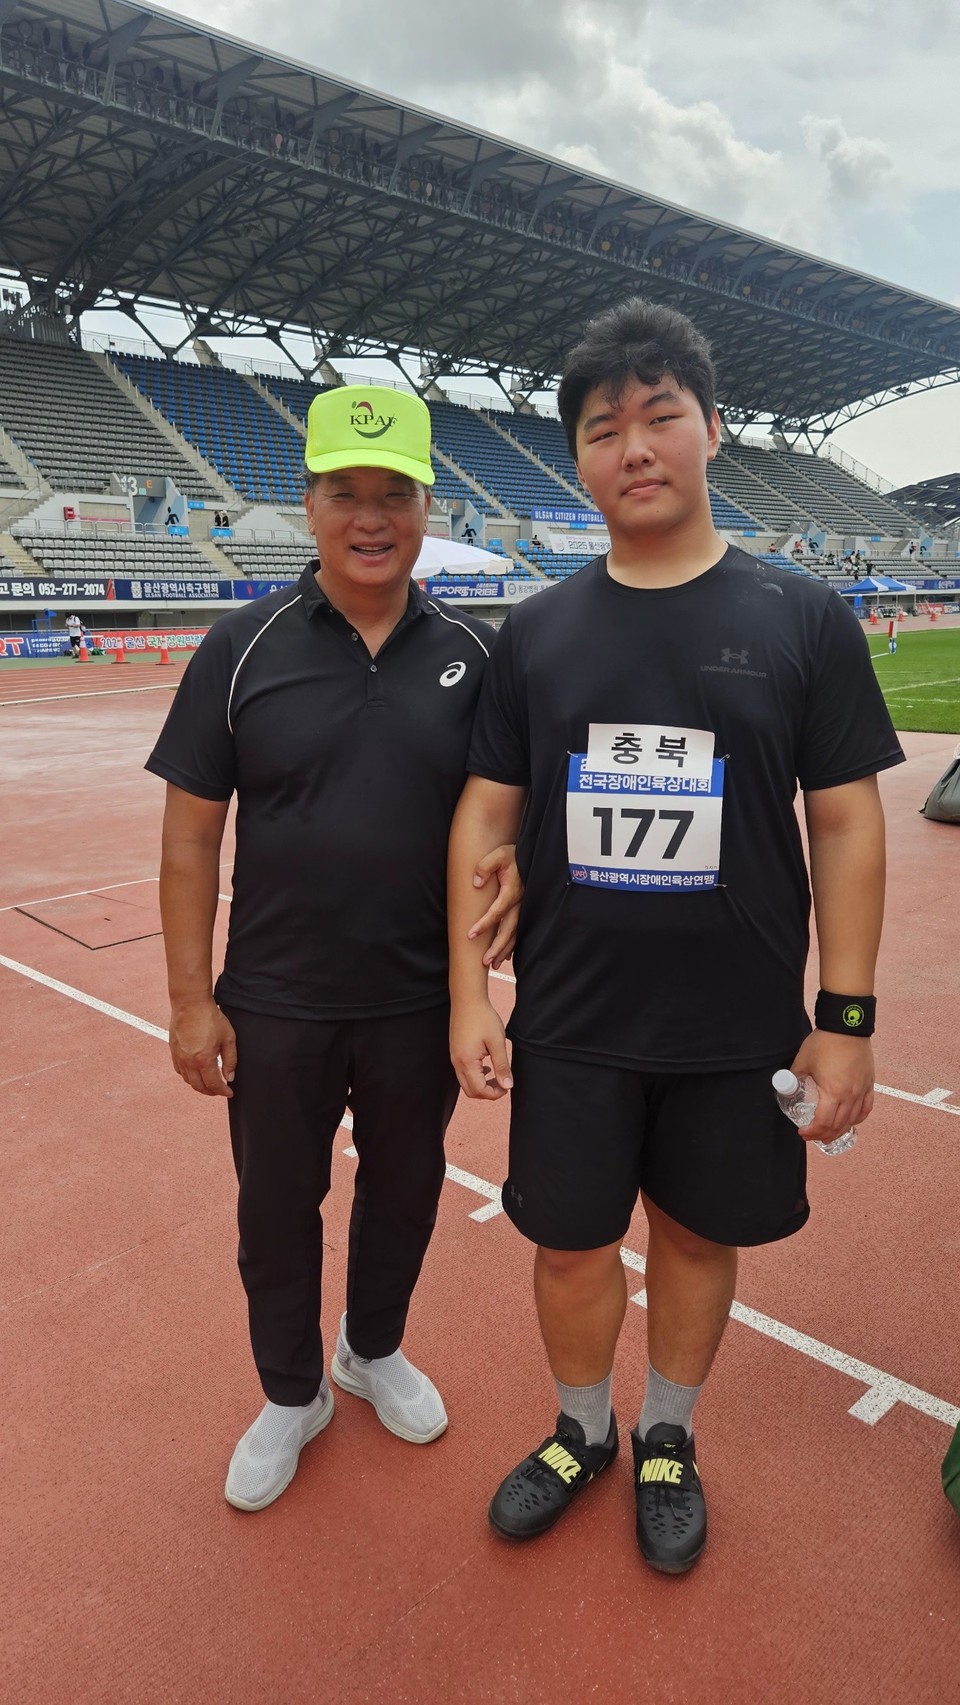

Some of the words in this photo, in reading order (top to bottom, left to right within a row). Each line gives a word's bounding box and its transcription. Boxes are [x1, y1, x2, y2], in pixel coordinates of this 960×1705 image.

[534, 511, 553, 520] ULSAN
[555, 512, 576, 521] CITIZEN
[578, 514, 604, 523] FOOTBALL
[568, 541, 588, 550] 2025
[11, 582, 35, 597] 문의
[38, 583, 105, 597] 052-277-2074
[143, 582, 219, 594] 울산광역시축구협회
[125, 636, 145, 649] 울산
[731, 668, 767, 678] ARMOUR
[579, 774, 712, 793] 전국장애인육상대회
[593, 807, 694, 860] 177
[589, 870, 715, 886] 울산광역시장애인육상연맹
[538, 1442, 582, 1484] NIKE
[640, 1458, 683, 1484] NIKE
